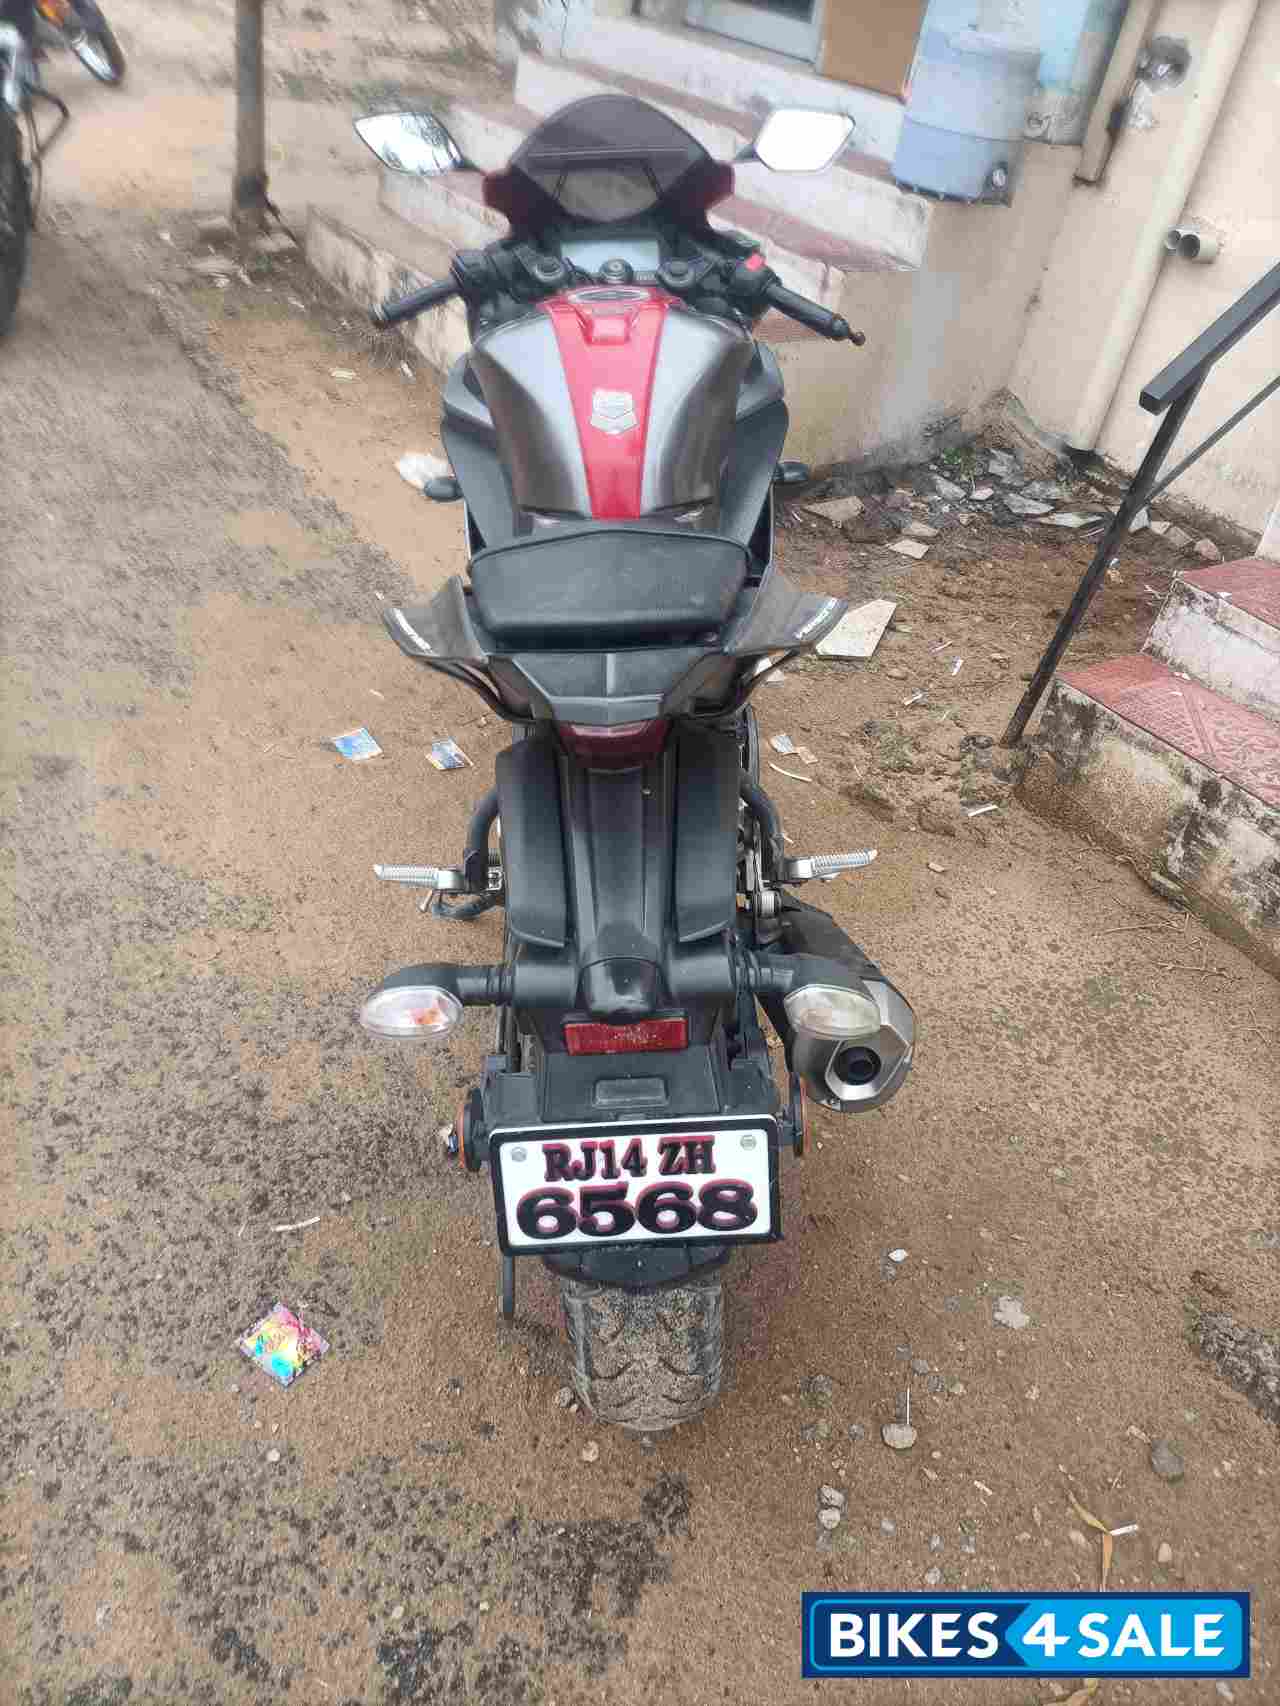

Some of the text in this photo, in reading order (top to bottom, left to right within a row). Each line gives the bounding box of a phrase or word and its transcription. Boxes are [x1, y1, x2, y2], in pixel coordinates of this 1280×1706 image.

[542, 1135, 717, 1182] RJ14 ZH
[516, 1178, 758, 1239] 6568
